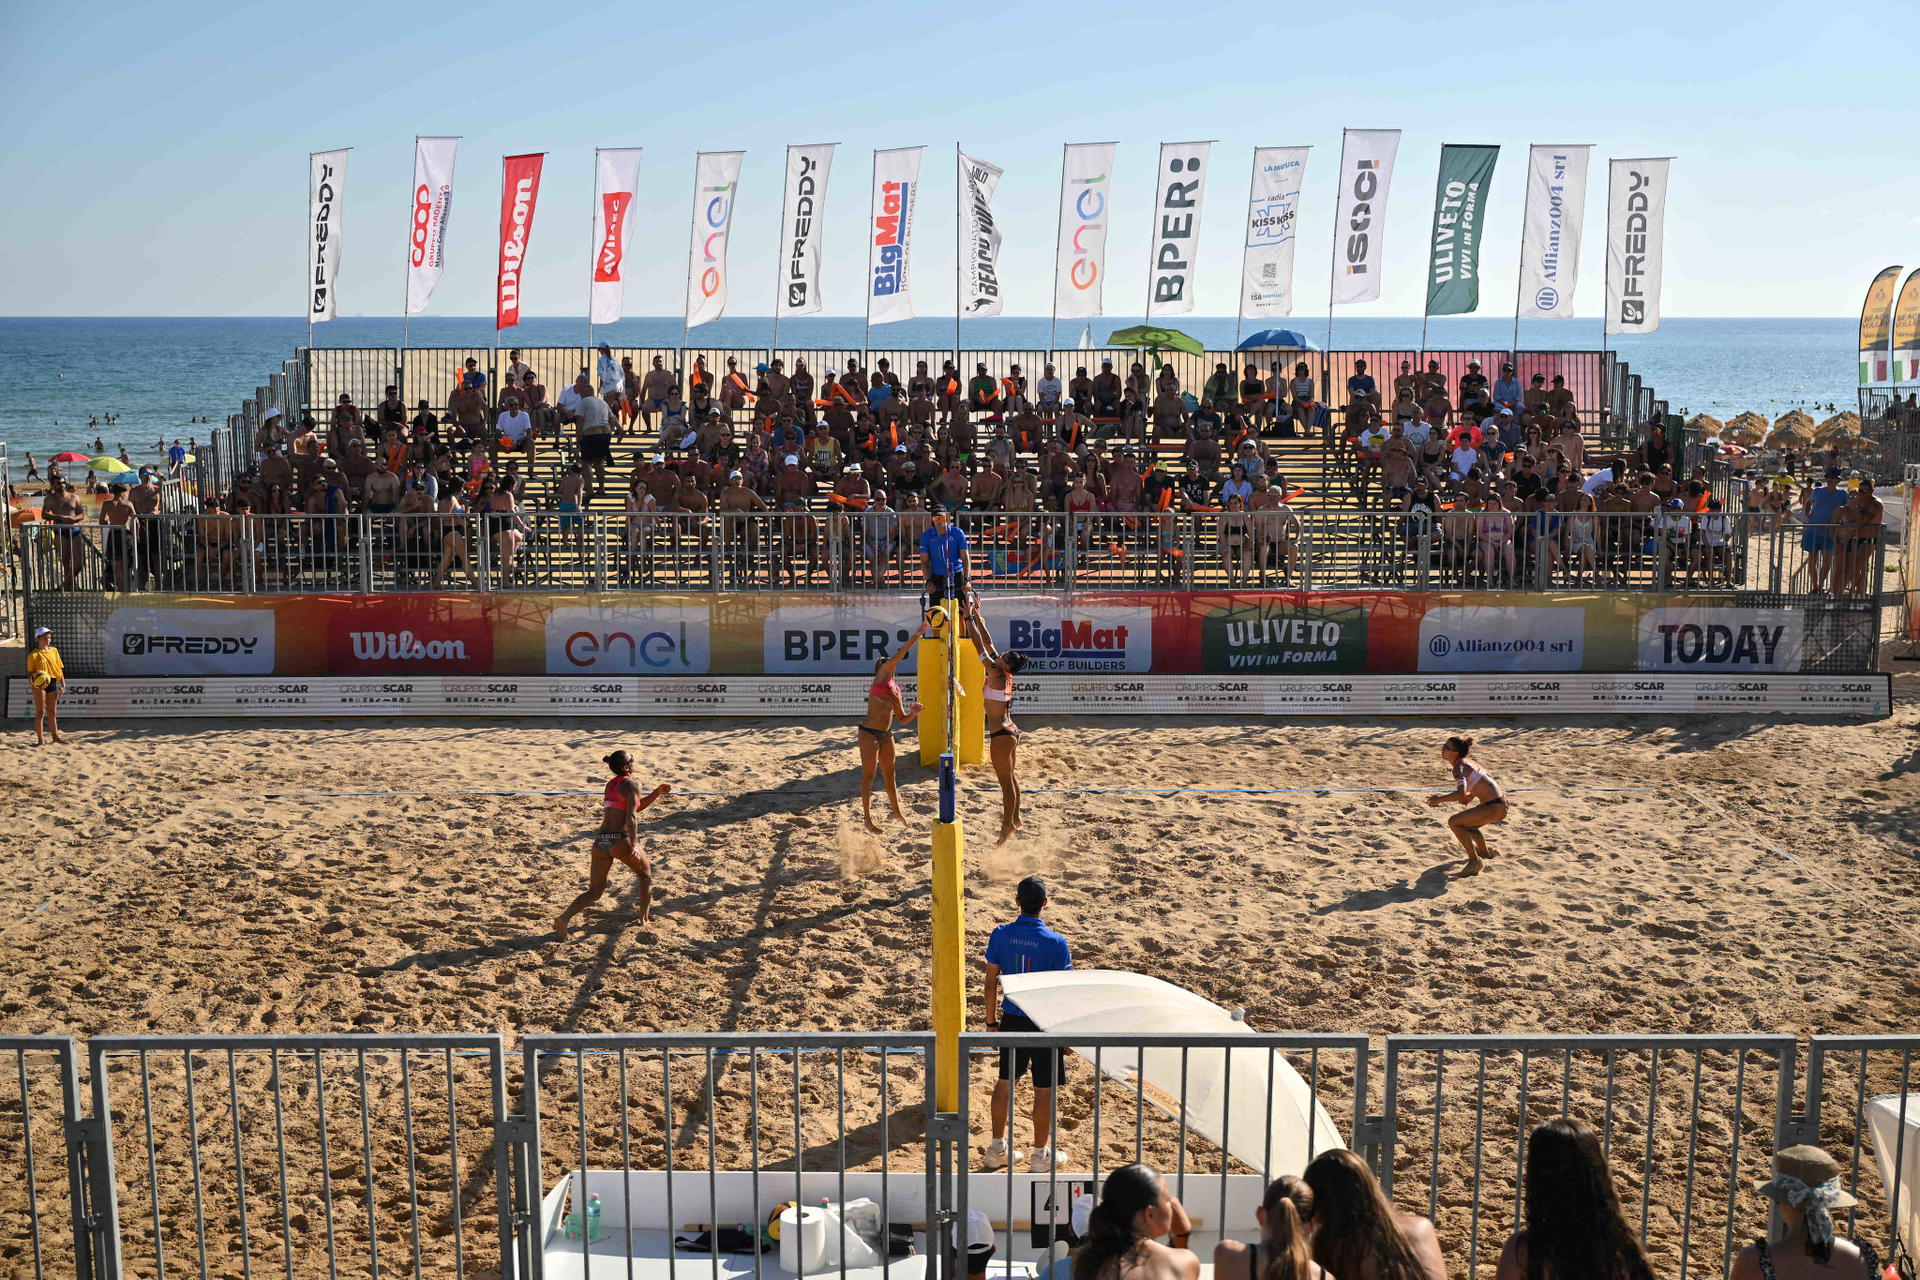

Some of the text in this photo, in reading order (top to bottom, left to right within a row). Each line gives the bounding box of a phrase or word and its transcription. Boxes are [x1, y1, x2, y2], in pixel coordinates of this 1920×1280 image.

[315, 164, 335, 285] FREDDY
[702, 180, 737, 298] enel
[790, 156, 817, 280] FREDDY
[874, 181, 902, 297] BigMat
[1071, 173, 1107, 290] enel
[1252, 216, 1276, 228] KISS
[1435, 181, 1466, 284] ULIVETO
[1461, 183, 1479, 280] VIVI IN FORMA
[1624, 171, 1650, 297] FREDDY
[502, 175, 533, 314] Wilson
[147, 636, 258, 655] FREDDY
[349, 630, 469, 660] Wilson
[565, 620, 691, 668] enel
[1009, 620, 1129, 657] BigMat
[1226, 618, 1341, 647] ULIVETO
[1454, 639, 1573, 652] Allianz004 srl
[1657, 623, 1786, 665] TODAY
[1022, 660, 1126, 671] OME OF BUILDERS
[1229, 650, 1338, 668] VIVI IN FORMA
